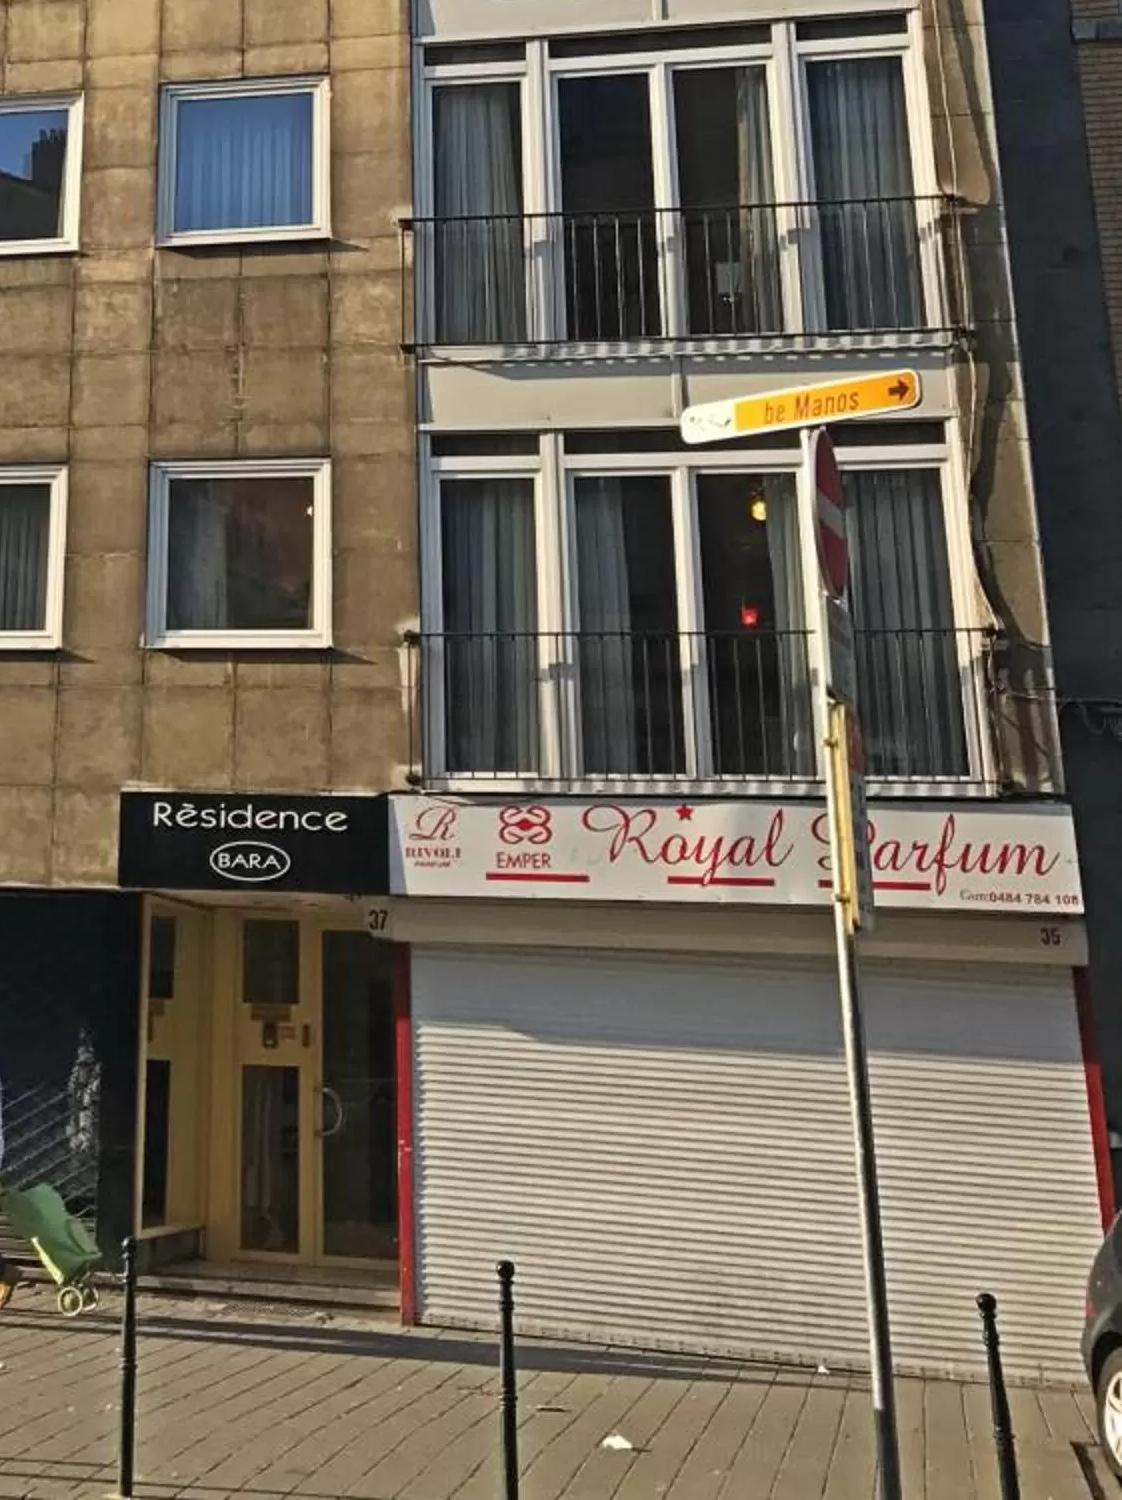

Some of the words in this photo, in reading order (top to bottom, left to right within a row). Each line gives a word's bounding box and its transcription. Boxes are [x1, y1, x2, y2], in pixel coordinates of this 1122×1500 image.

[763, 400, 786, 425] be
[793, 388, 860, 418] Manos
[405, 847, 461, 859] RIVOLI
[581, 803, 795, 887] Royal
[217, 853, 281, 870] BARA
[496, 851, 552, 870] EMPER
[368, 908, 390, 931] 37
[1040, 927, 1061, 946] 35
